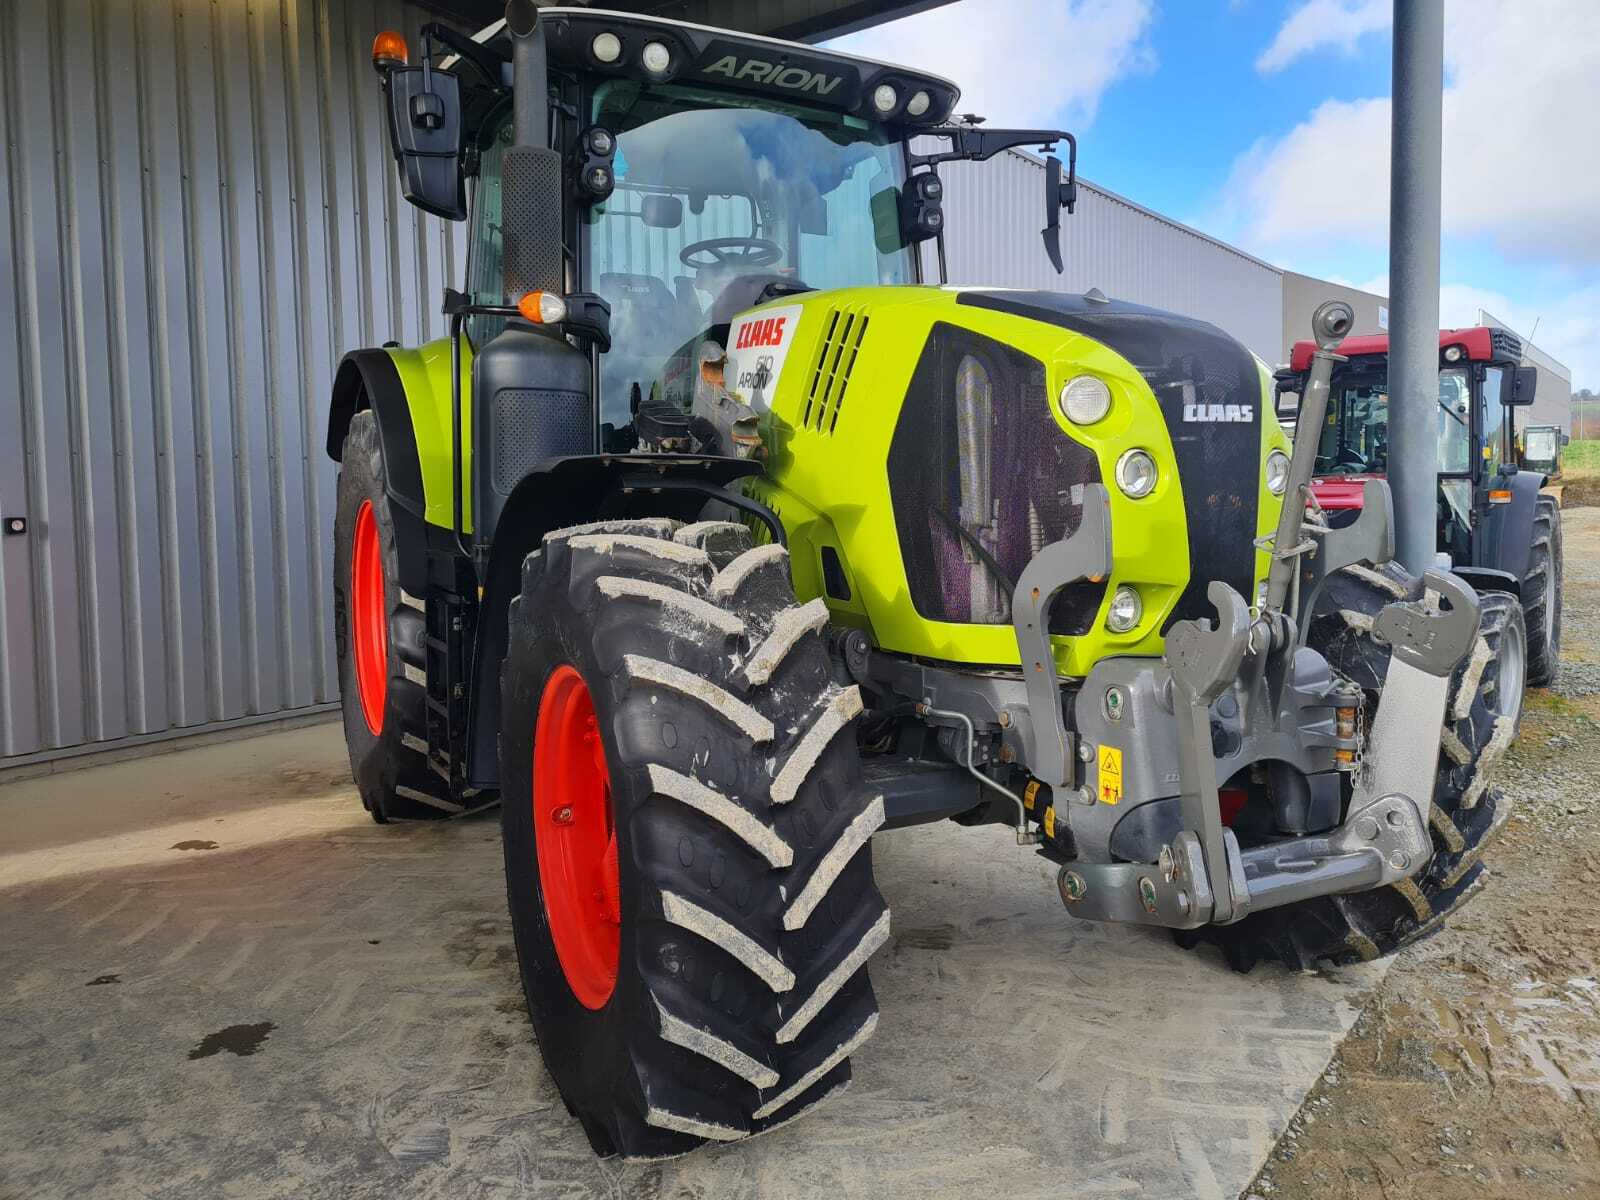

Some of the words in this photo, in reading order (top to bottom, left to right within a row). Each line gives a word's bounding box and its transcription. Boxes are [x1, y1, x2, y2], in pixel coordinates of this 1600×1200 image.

[736, 317, 786, 350] CLAAS
[738, 371, 769, 390] ARION
[1183, 404, 1253, 422] CLAAS
